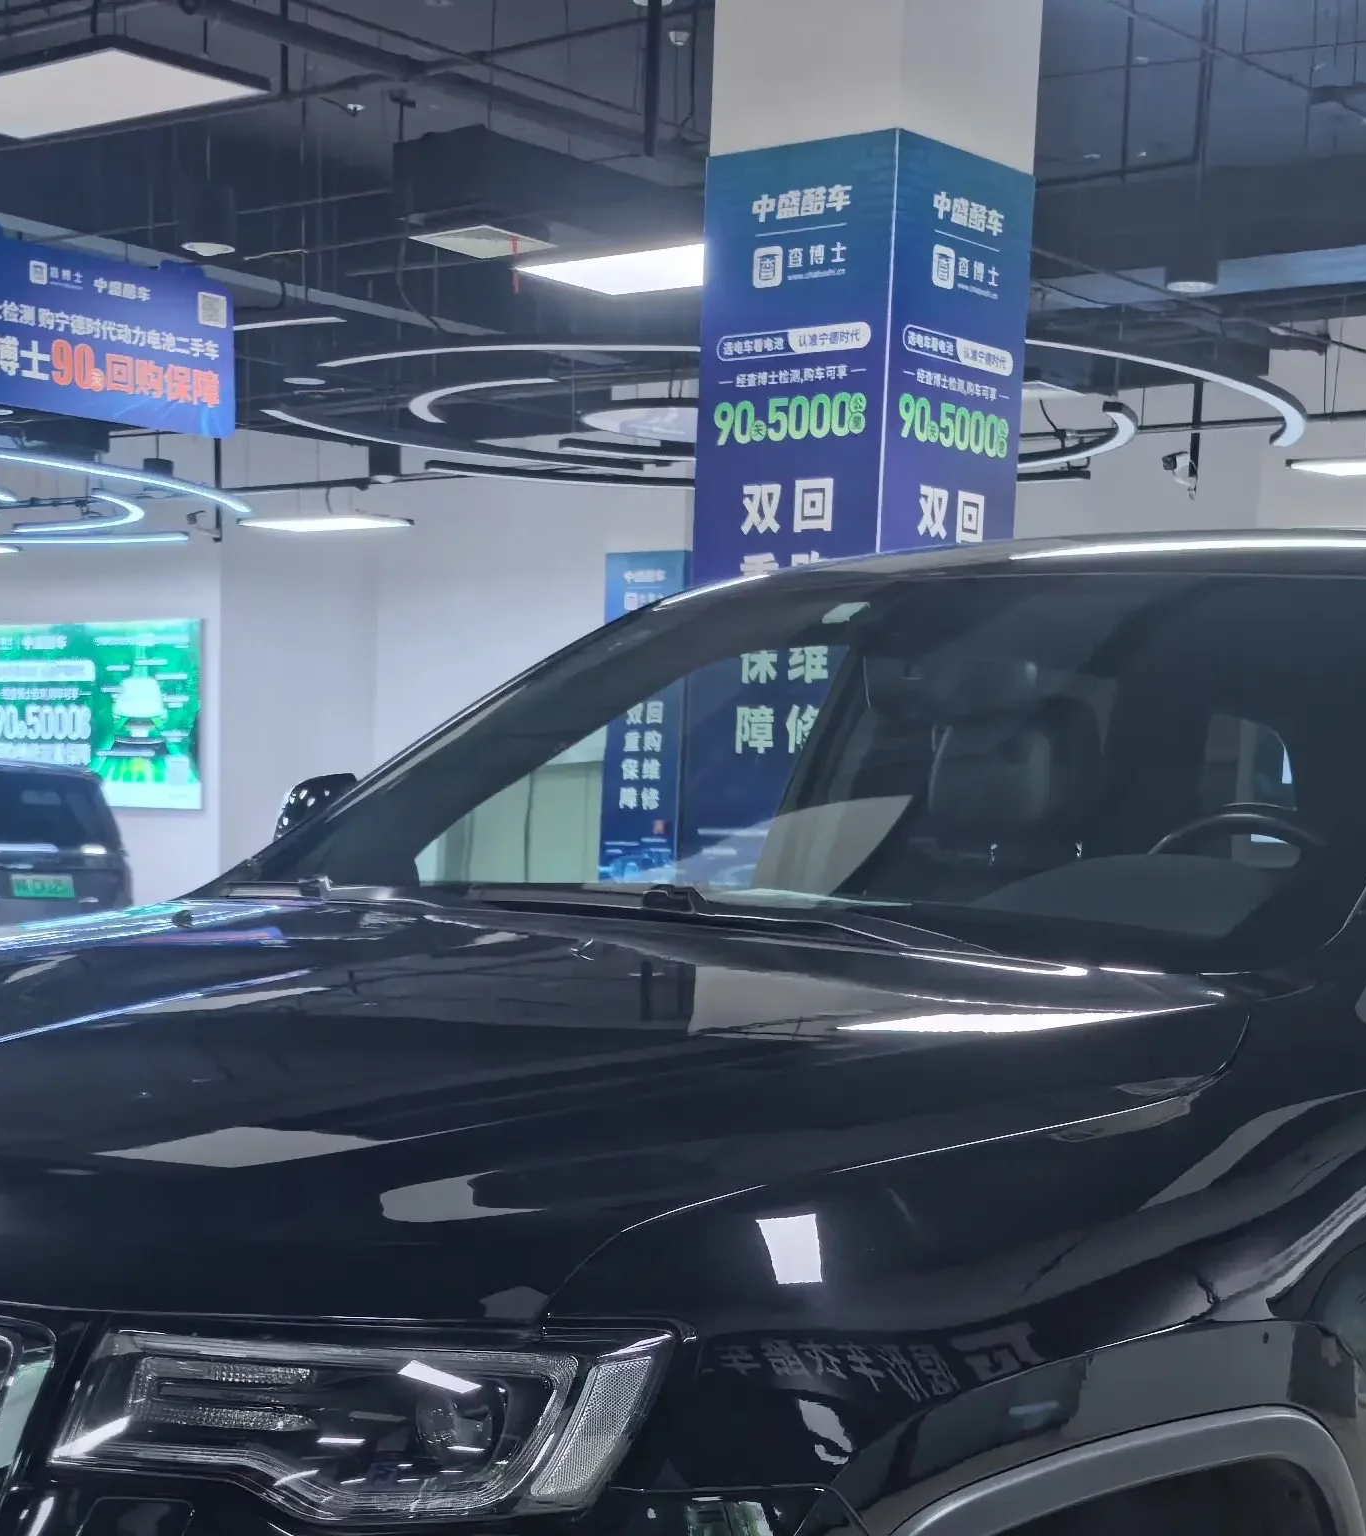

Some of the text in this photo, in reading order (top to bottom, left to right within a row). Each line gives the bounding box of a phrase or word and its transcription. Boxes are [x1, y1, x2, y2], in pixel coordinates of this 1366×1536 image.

[751, 183, 852, 222] 中盛酷车
[932, 191, 1005, 236] 中盛酷车
[787, 241, 847, 268] 查博士
[957, 256, 999, 287] 查博士
